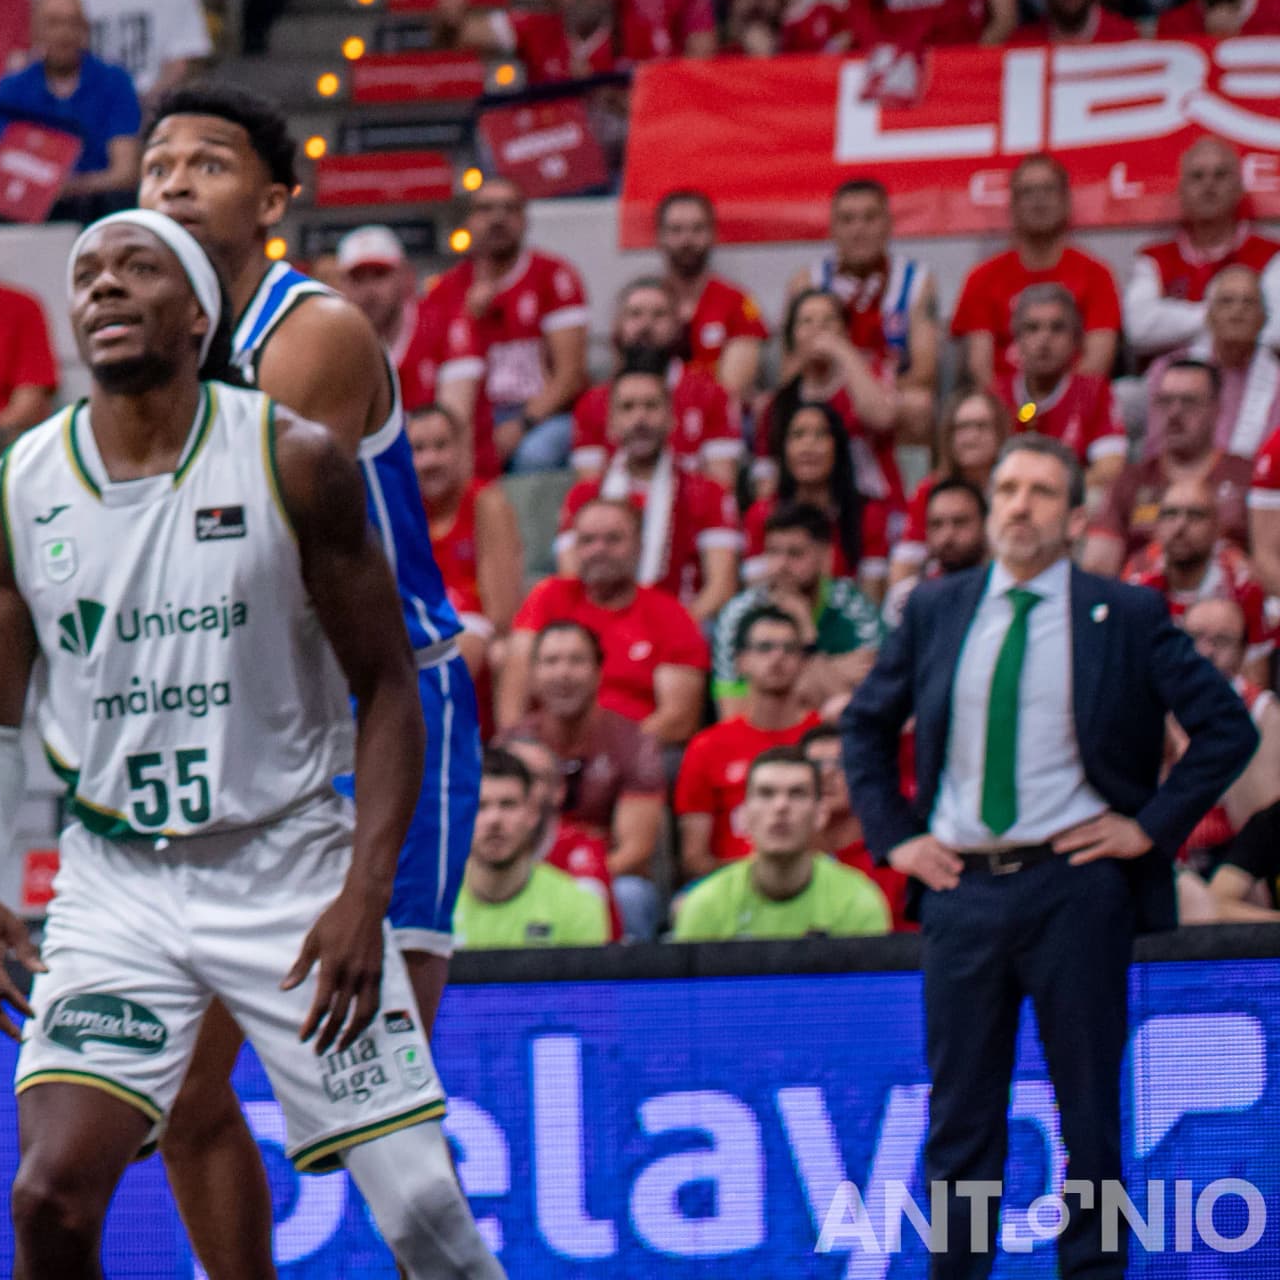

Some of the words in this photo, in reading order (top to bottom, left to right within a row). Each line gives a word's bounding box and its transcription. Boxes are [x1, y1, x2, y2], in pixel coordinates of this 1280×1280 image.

[115, 595, 248, 643] Unicaja
[94, 676, 232, 721] málaga
[125, 748, 211, 826] 55
